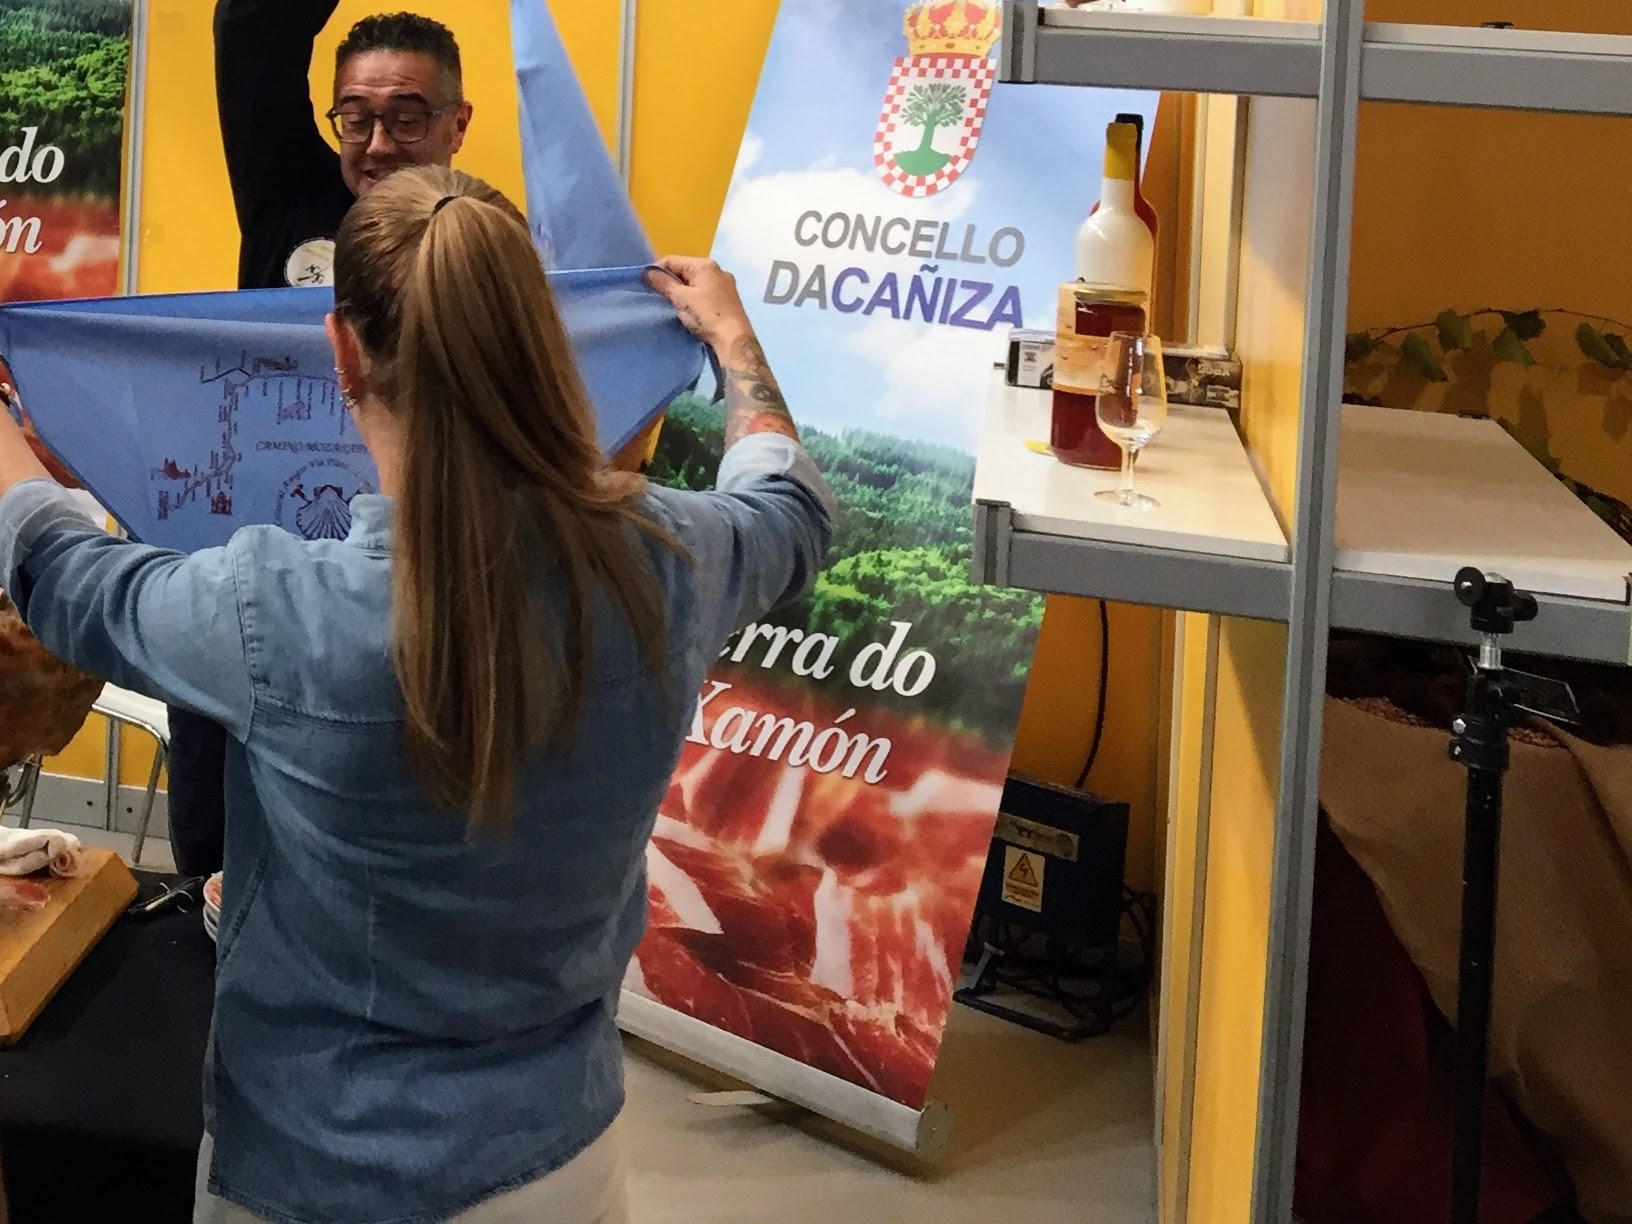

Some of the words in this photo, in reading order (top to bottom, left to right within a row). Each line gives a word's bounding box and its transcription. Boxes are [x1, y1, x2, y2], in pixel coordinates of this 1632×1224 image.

[794, 210, 1025, 267] CONCELLO
[849, 621, 937, 697] do
[685, 680, 893, 784] Xamón
